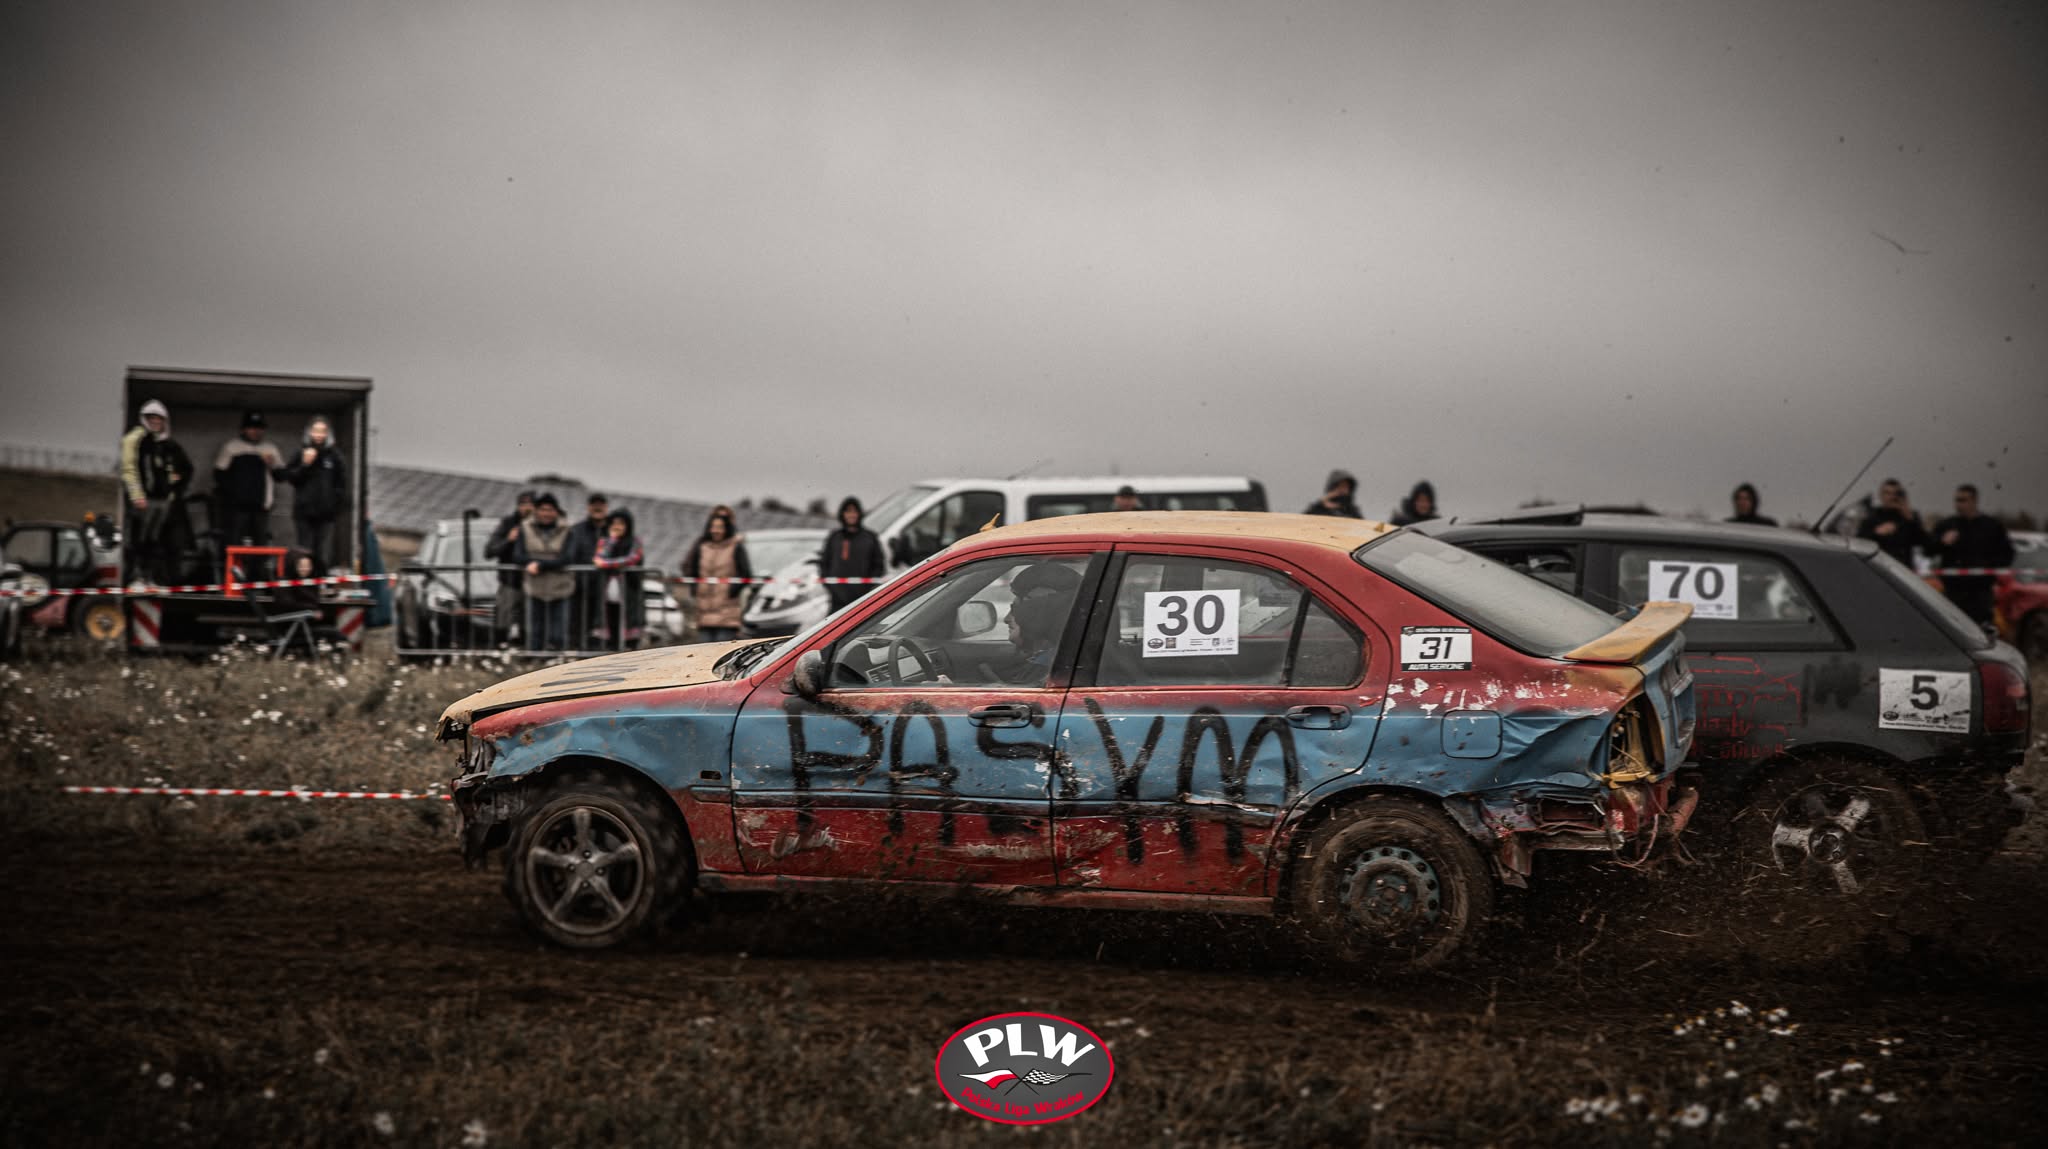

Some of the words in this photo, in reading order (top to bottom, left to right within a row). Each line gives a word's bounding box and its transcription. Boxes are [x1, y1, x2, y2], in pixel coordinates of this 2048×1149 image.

[1663, 565, 1724, 600] 70
[1157, 594, 1224, 636] 30
[1419, 637, 1453, 659] 31
[1910, 675, 1939, 710] 5
